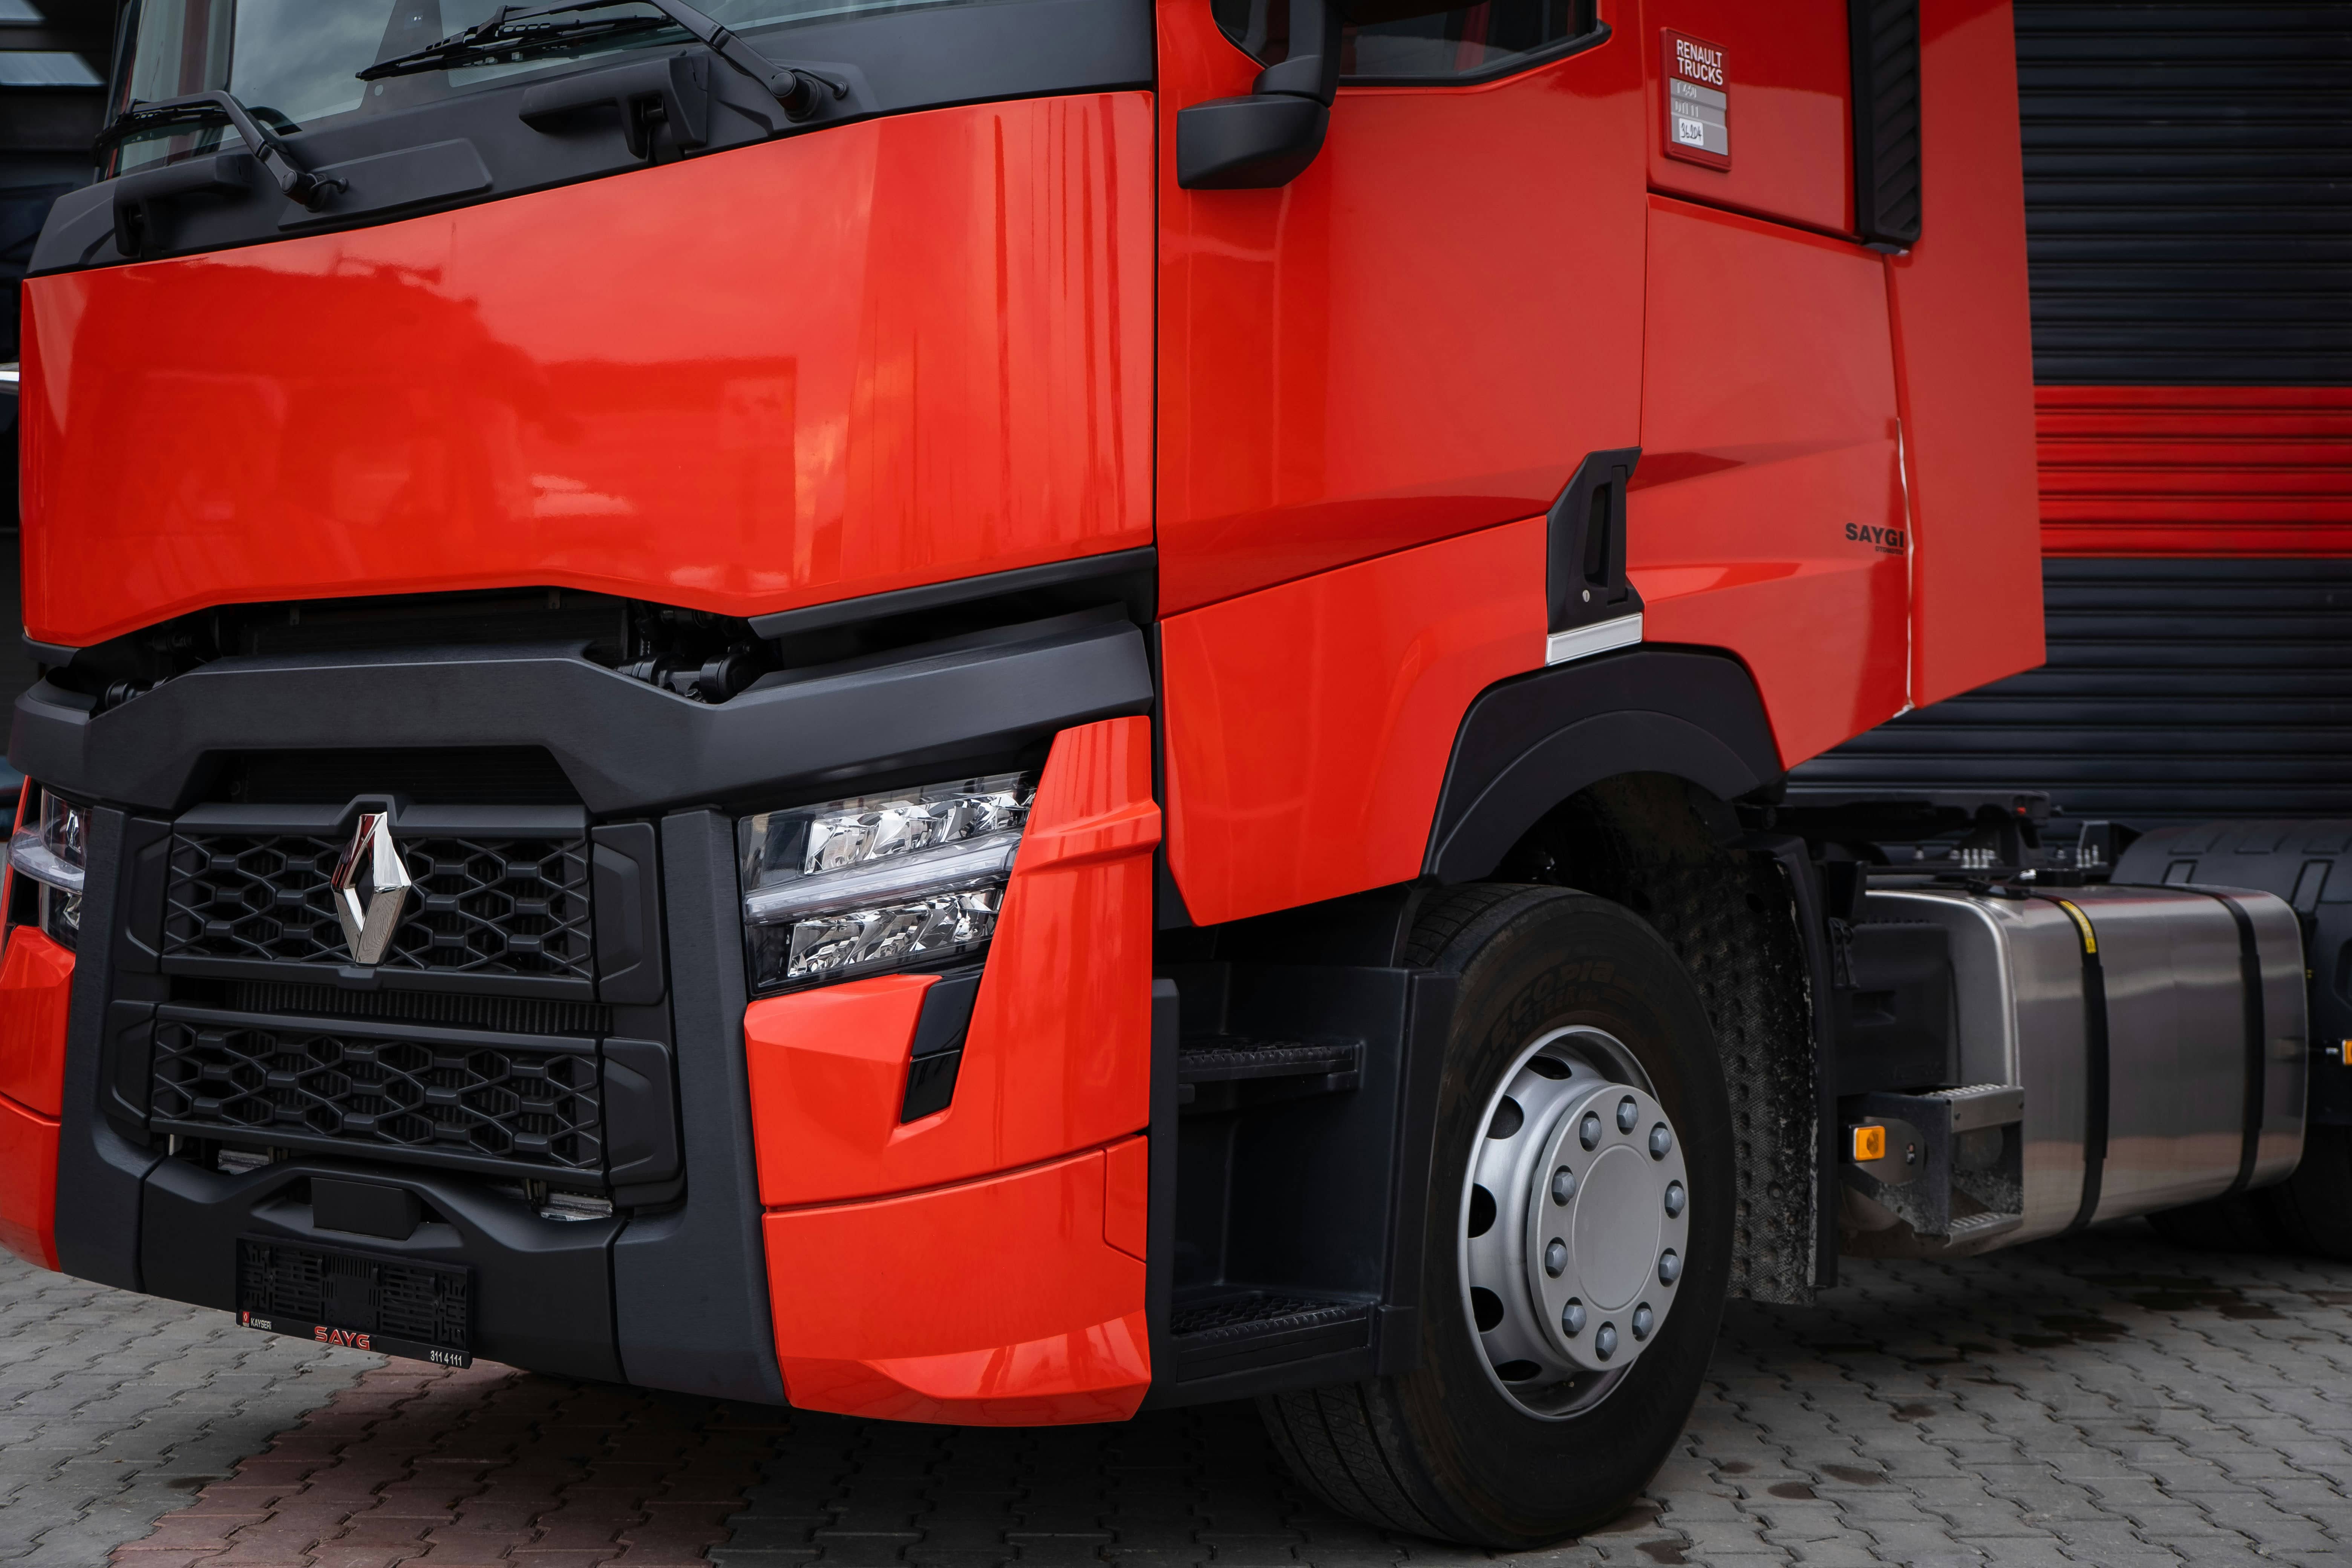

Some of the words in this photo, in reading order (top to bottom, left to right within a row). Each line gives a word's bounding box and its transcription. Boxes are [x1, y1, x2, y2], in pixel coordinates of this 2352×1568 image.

[1677, 39, 1722, 68] RENAULT
[1677, 57, 1723, 86] TRUCKS
[1845, 522, 1904, 547] SAYGI
[314, 1326, 370, 1351] SAYG
